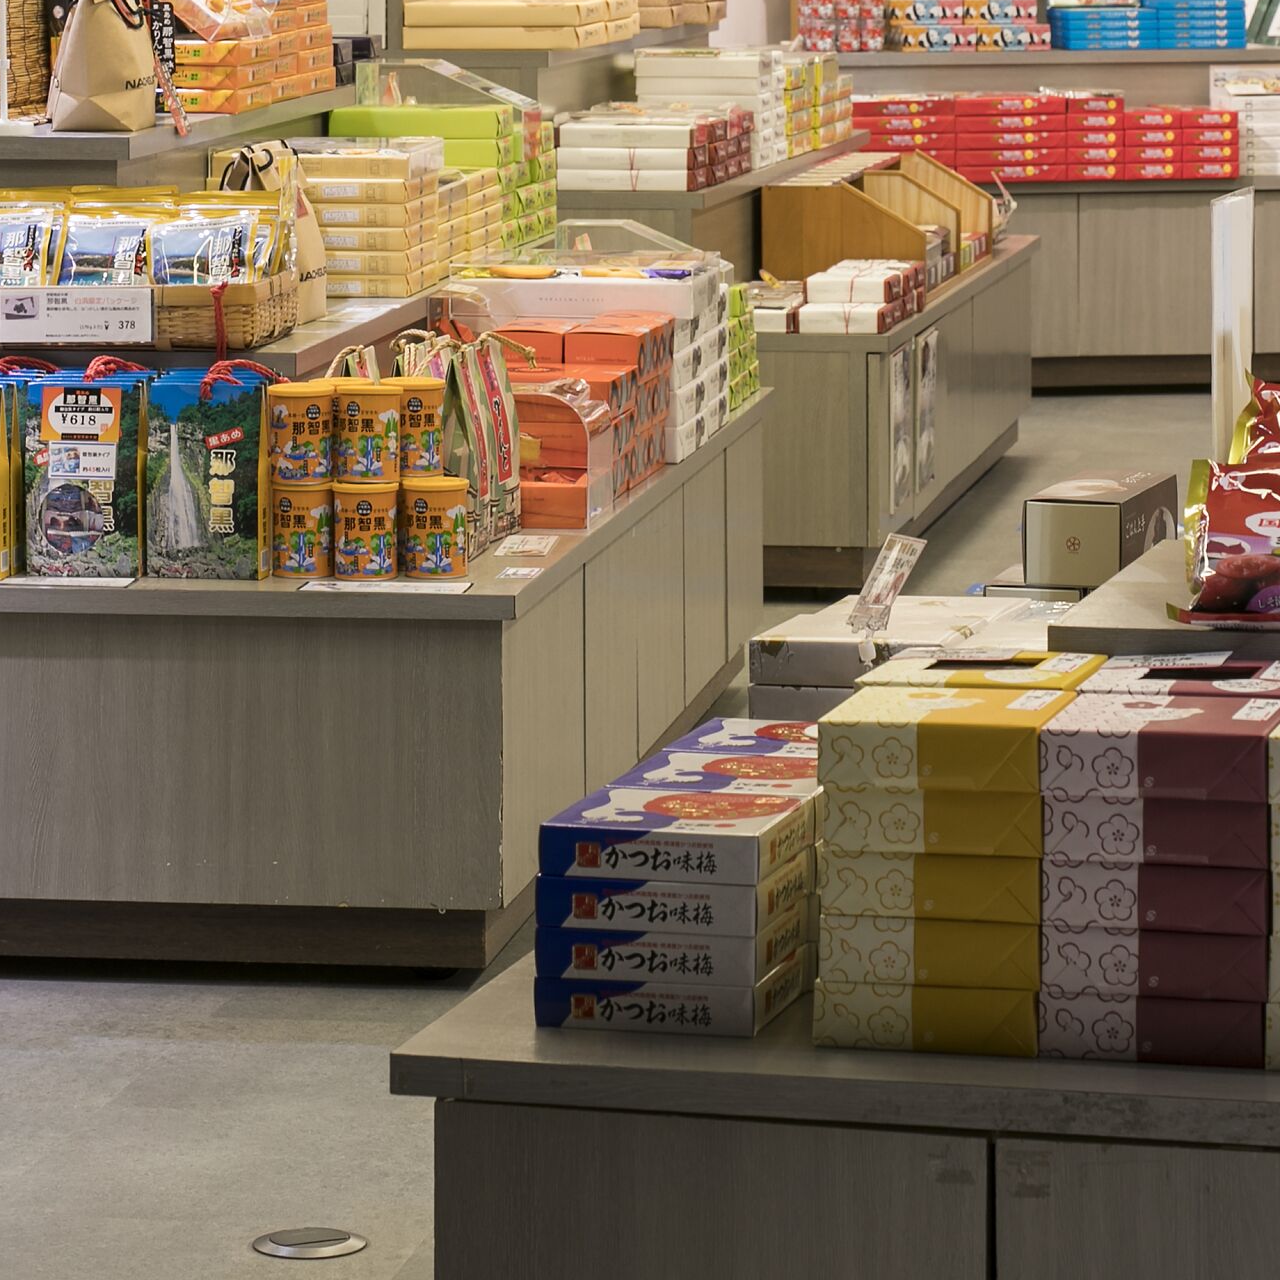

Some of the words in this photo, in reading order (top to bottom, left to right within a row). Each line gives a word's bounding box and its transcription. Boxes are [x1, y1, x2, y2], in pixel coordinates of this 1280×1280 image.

[118, 320, 136, 329] 378
[61, 413, 97, 426] ¥618
[292, 419, 331, 436] 那智黒
[210, 428, 243, 448] 黒あめ
[209, 449, 236, 534] 那智黒
[344, 517, 387, 531] 那智黒
[604, 846, 719, 875] かつお味梅
[601, 896, 715, 927] かつお味梅
[601, 948, 715, 977] かつお味梅
[599, 999, 713, 1027] かつお味梅
